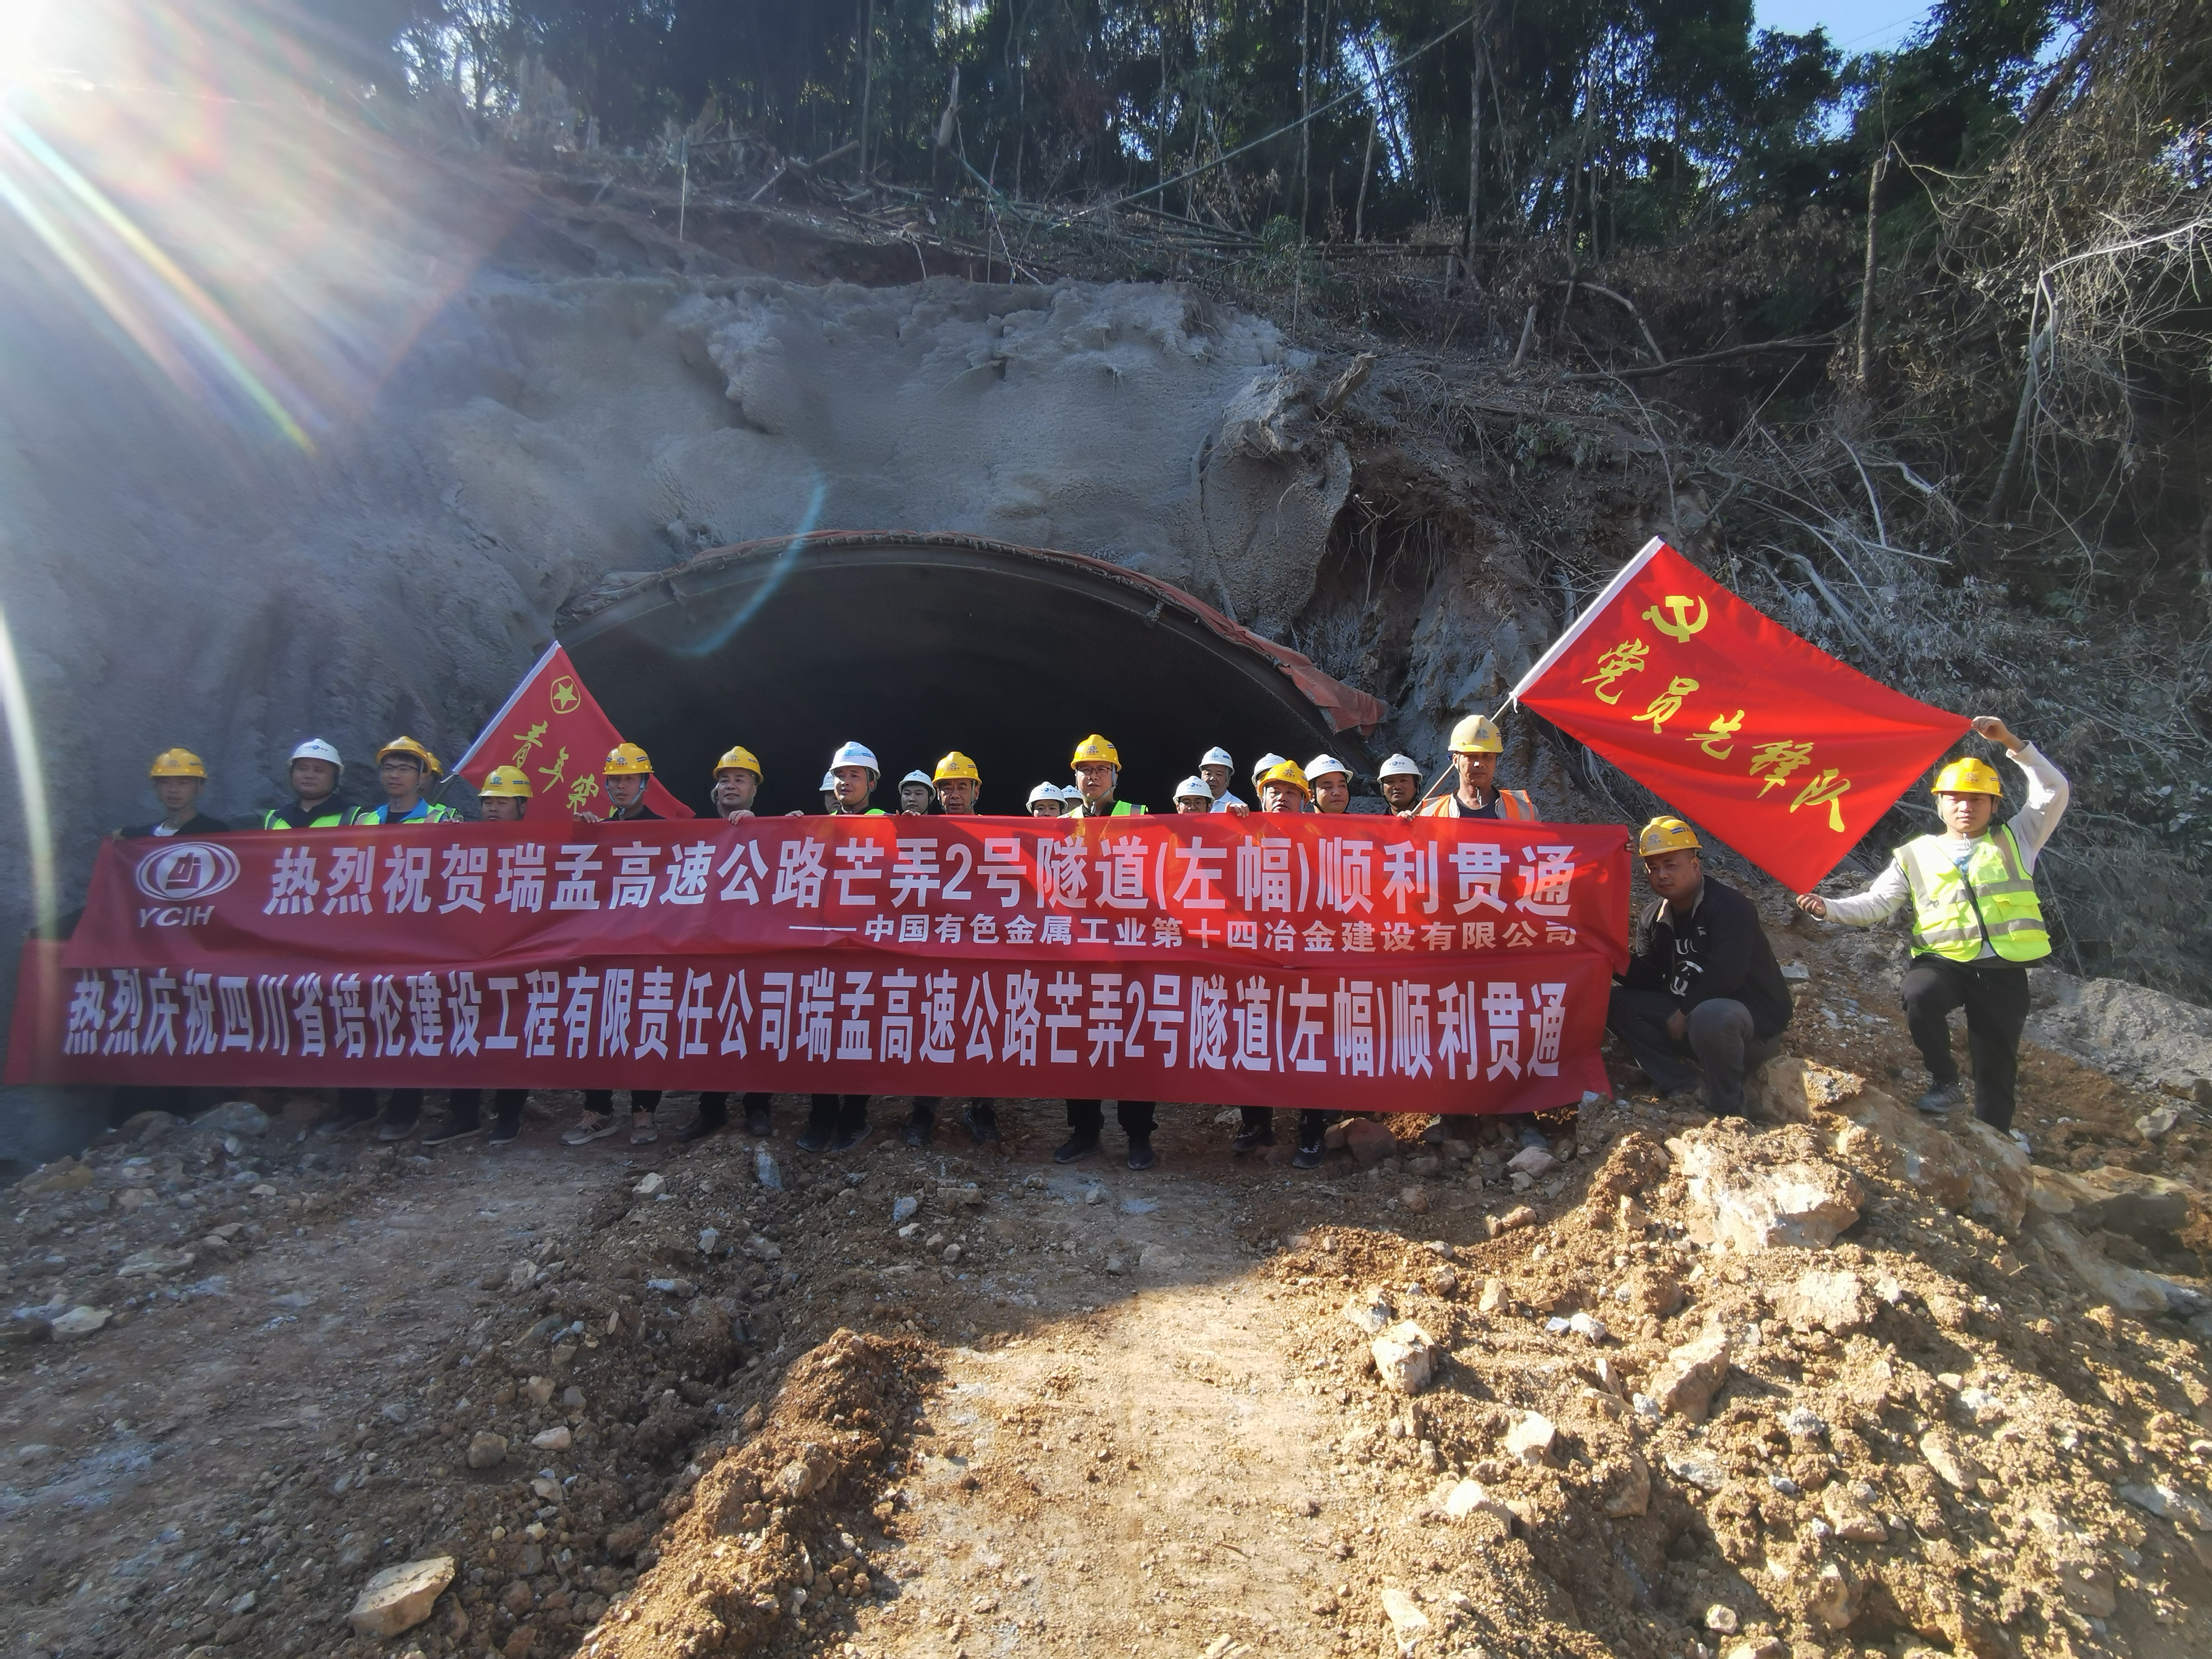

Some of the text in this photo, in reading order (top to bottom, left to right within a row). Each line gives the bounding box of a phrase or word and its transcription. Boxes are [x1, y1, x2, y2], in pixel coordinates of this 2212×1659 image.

[263, 836, 1575, 917] 热烈祝贺瑞孟高速公路芒弄2号隧道(左幅)顺利贯通
[64, 966, 1567, 1082] 热烈庆祝四川省培伦建设工程有限责任公司瑞孟高速公路芒弄2号隧道(左幅)顺利贯通
